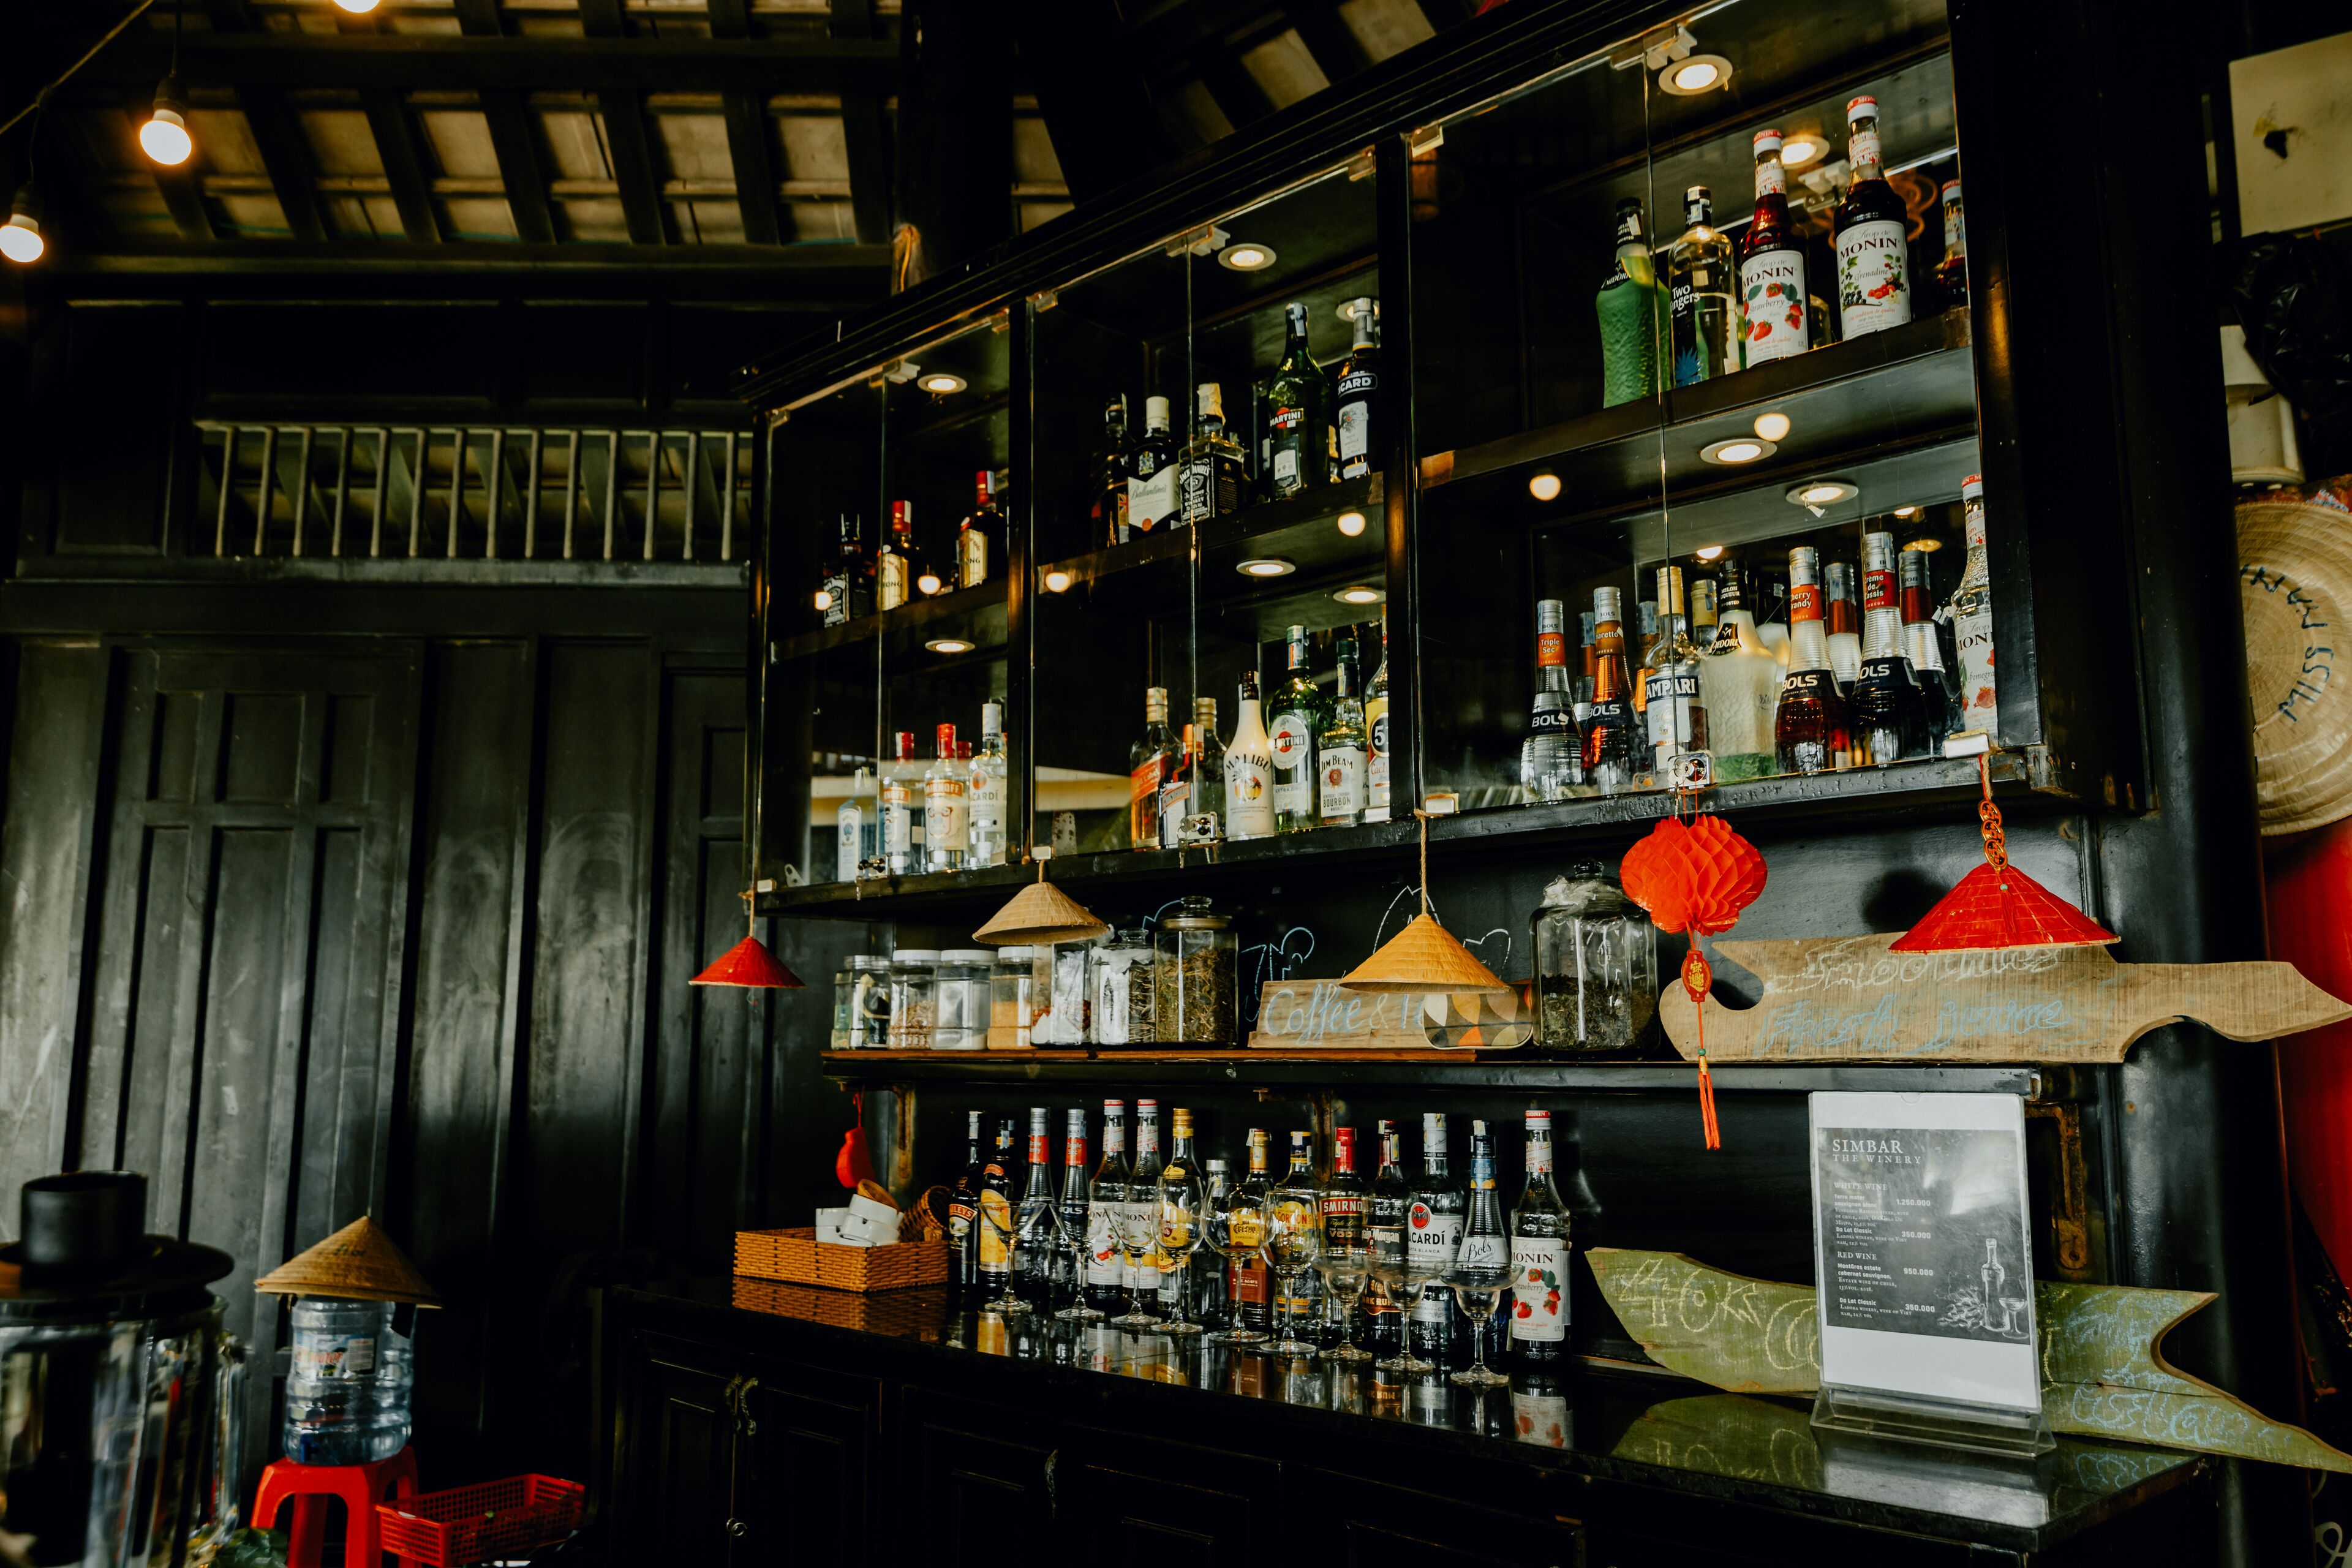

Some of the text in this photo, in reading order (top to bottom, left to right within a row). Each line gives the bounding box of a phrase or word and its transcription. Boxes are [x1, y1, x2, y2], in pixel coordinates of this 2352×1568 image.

[1840, 238, 1898, 262] MONIN
[1743, 266, 1794, 290] MONIN
[1854, 267, 1889, 281] Grenadine
[1672, 284, 1691, 300] Two
[1749, 298, 1785, 314] Strawberry
[1270, 411, 1302, 428] MARTINI
[1540, 638, 1560, 647] Triple
[1781, 674, 1818, 692] BOLS
[1968, 671, 1995, 684] Pomegra
[2278, 646, 2334, 722] MISS
[1646, 677, 1696, 699] AMPARI
[1588, 704, 1621, 718] BOLS
[1226, 753, 1272, 773] MALIBU
[1321, 755, 1353, 775] JIM BEAM
[971, 789, 999, 801] CARDÍ
[1323, 796, 1351, 808] BOURBON
[1264, 981, 1364, 1045] Coffee
[1368, 992, 1389, 1030] &
[1833, 1139, 1904, 1154] SIMBAR
[1832, 1154, 1921, 1164] THE WINERY
[1324, 1200, 1363, 1213] SMIRNO
[1233, 1223, 1256, 1234] Cuervo
[1372, 1228, 1400, 1243] Morgan
[1901, 1231, 1931, 1239] 350.000
[1409, 1230, 1446, 1245] ACARDÍ
[1464, 1238, 1492, 1262] Bols
[1905, 1303, 1936, 1313] 350.000
